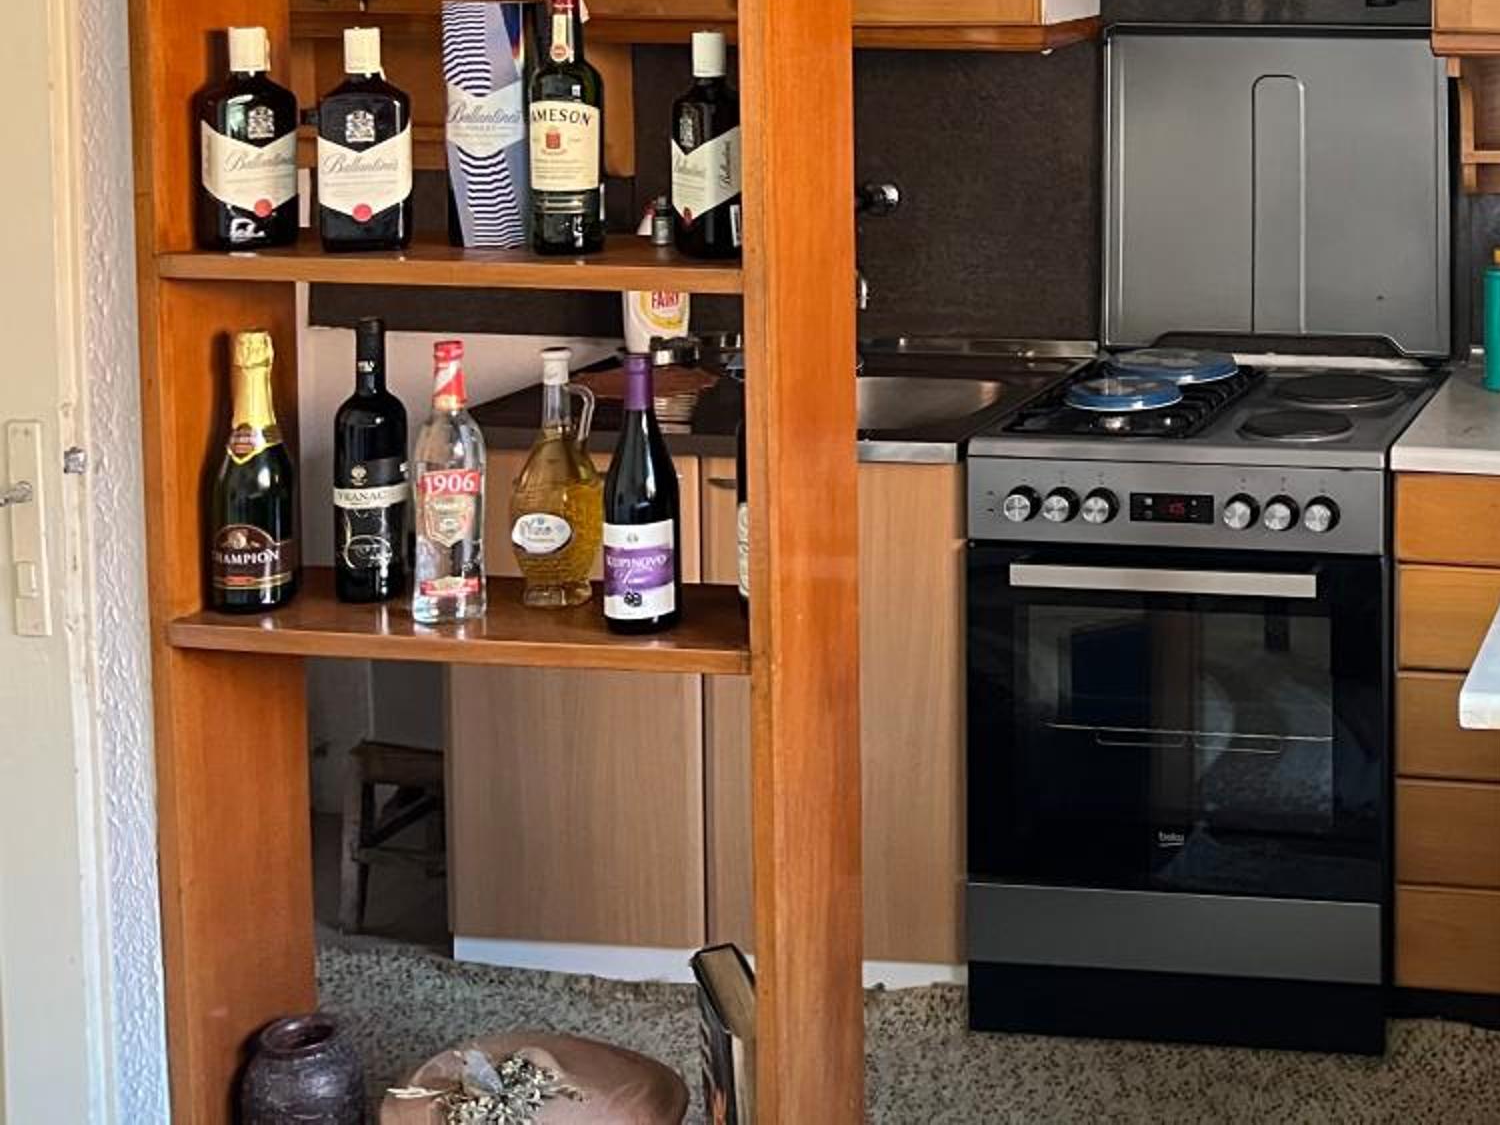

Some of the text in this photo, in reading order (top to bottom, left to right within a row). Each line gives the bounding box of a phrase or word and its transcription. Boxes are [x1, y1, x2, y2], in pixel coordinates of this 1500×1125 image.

[531, 108, 592, 126] AMESON
[424, 475, 476, 495] 1906
[337, 489, 386, 502] VRANAC
[217, 548, 280, 565] HAMPION
